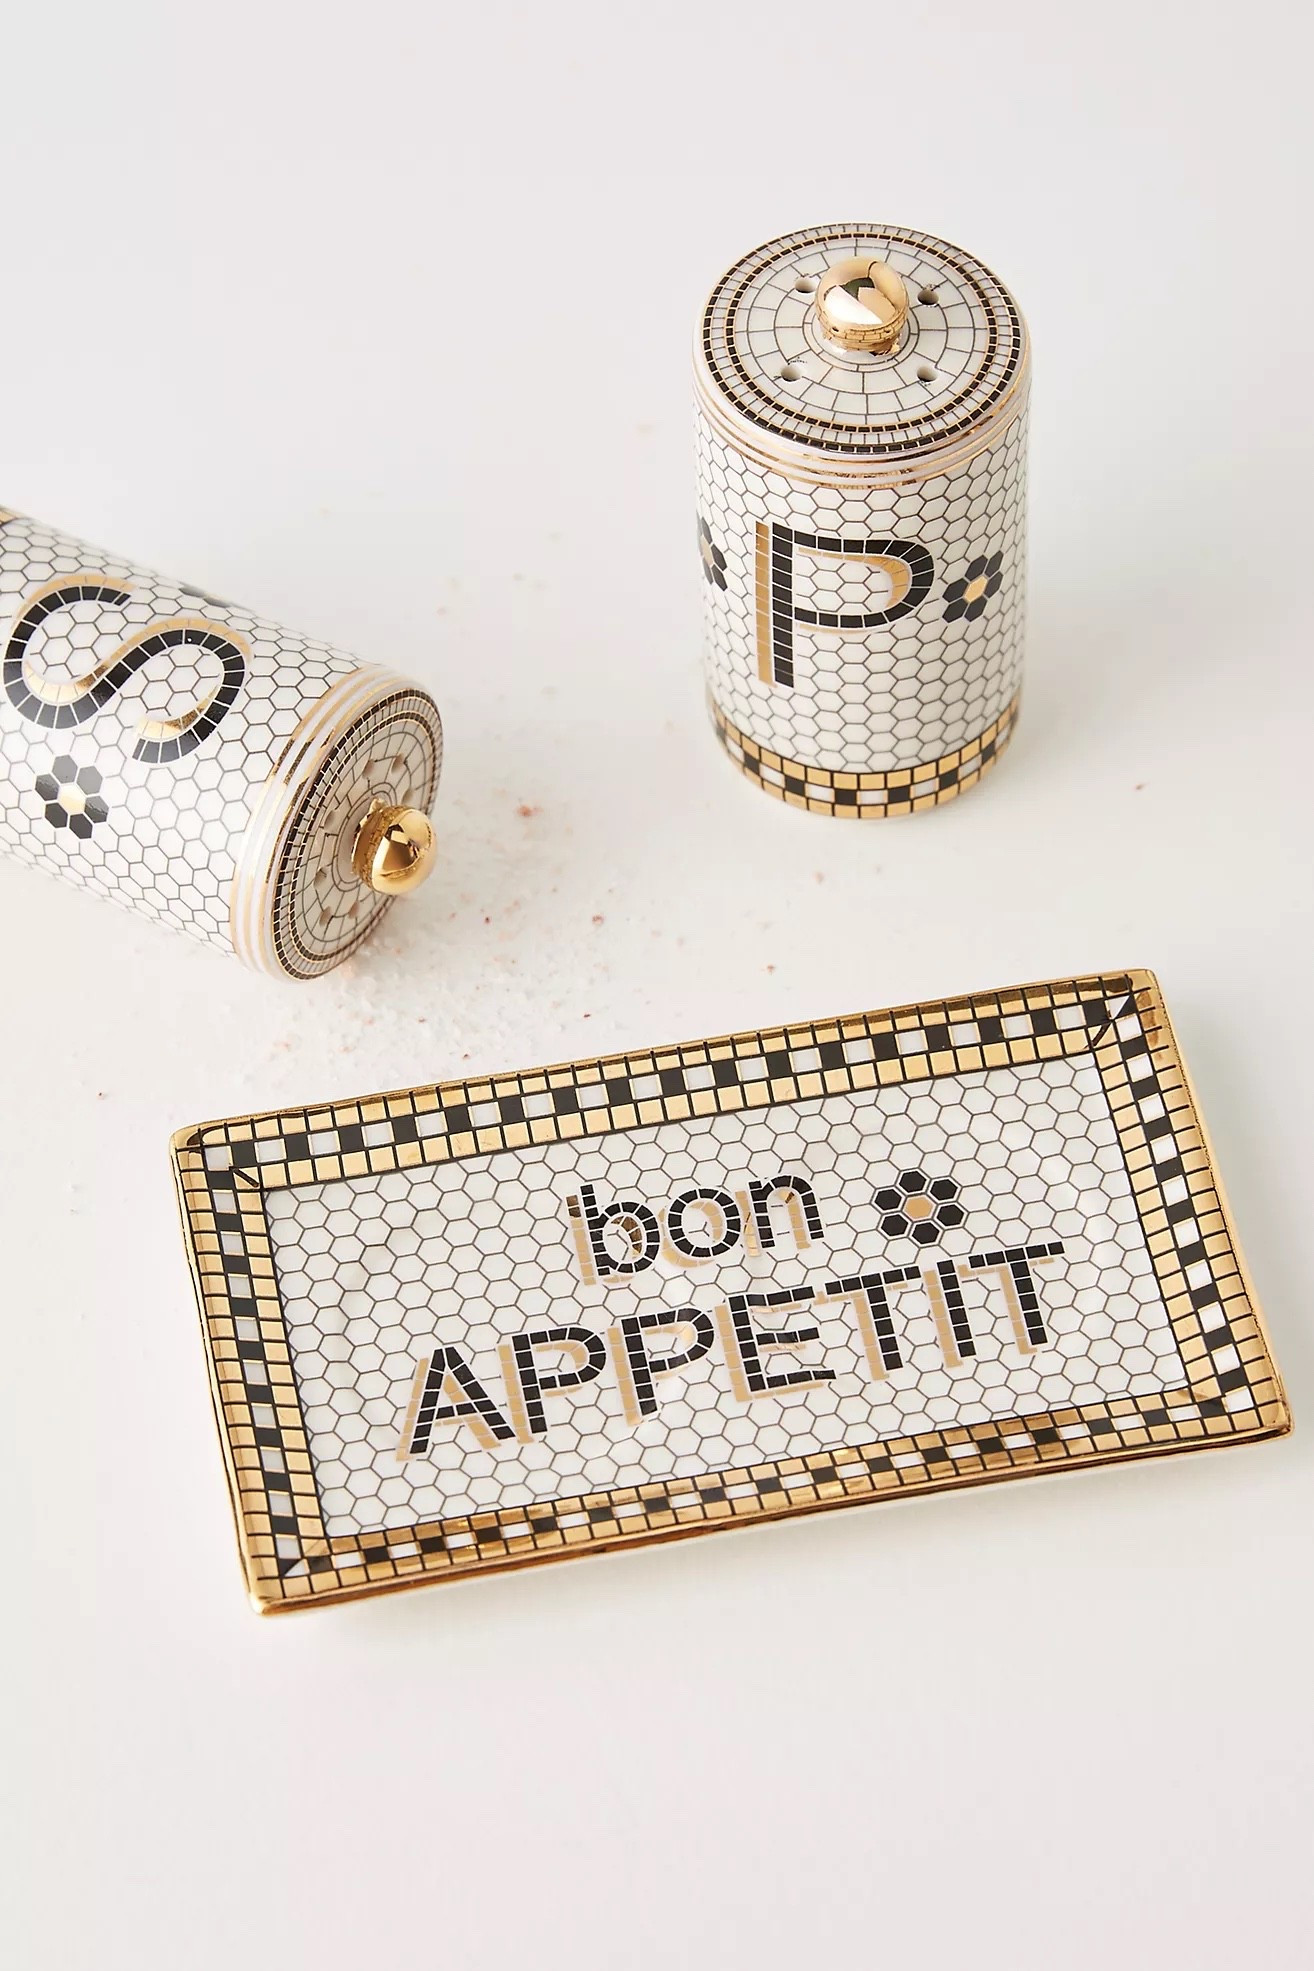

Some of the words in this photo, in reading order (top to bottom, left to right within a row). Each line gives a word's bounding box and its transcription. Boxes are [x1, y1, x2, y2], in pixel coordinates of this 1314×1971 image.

[3, 575, 251, 764] S
[756, 521, 935, 688] P
[567, 1173, 825, 1285] bon
[397, 1242, 1065, 1459] APPETIT
